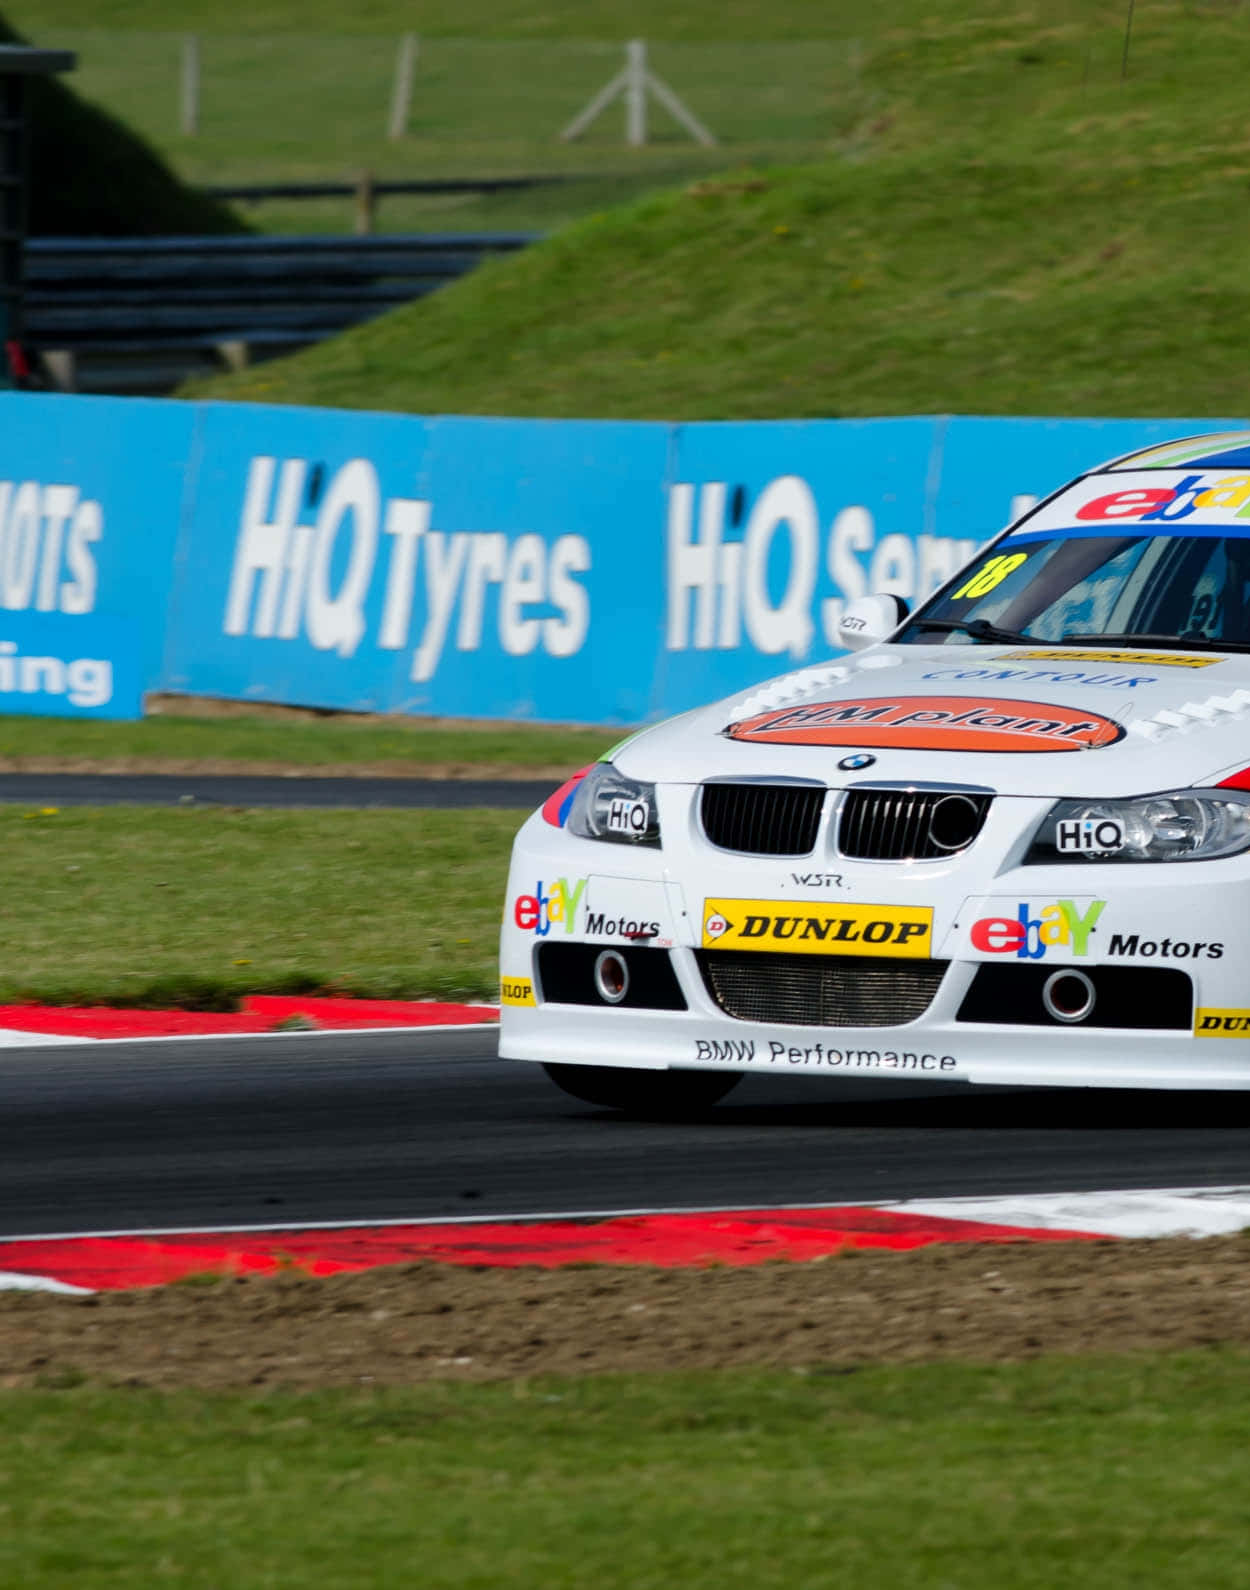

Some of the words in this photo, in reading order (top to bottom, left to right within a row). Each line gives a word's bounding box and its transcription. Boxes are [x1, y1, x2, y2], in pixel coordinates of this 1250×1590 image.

[223, 456, 380, 658] HiQ
[378, 498, 591, 682] Tyres
[665, 475, 819, 657] HiQ
[950, 552, 1028, 600] 18
[922, 669, 1159, 688] CONTOUR
[888, 707, 1098, 737] plant
[609, 801, 646, 830] HiQ
[1060, 821, 1122, 849] HiQ
[585, 913, 660, 937] Motors
[738, 915, 929, 944] DUNLOP
[1108, 934, 1225, 959] Motors
[695, 1039, 755, 1062] BMW
[768, 1041, 957, 1071] Performance
